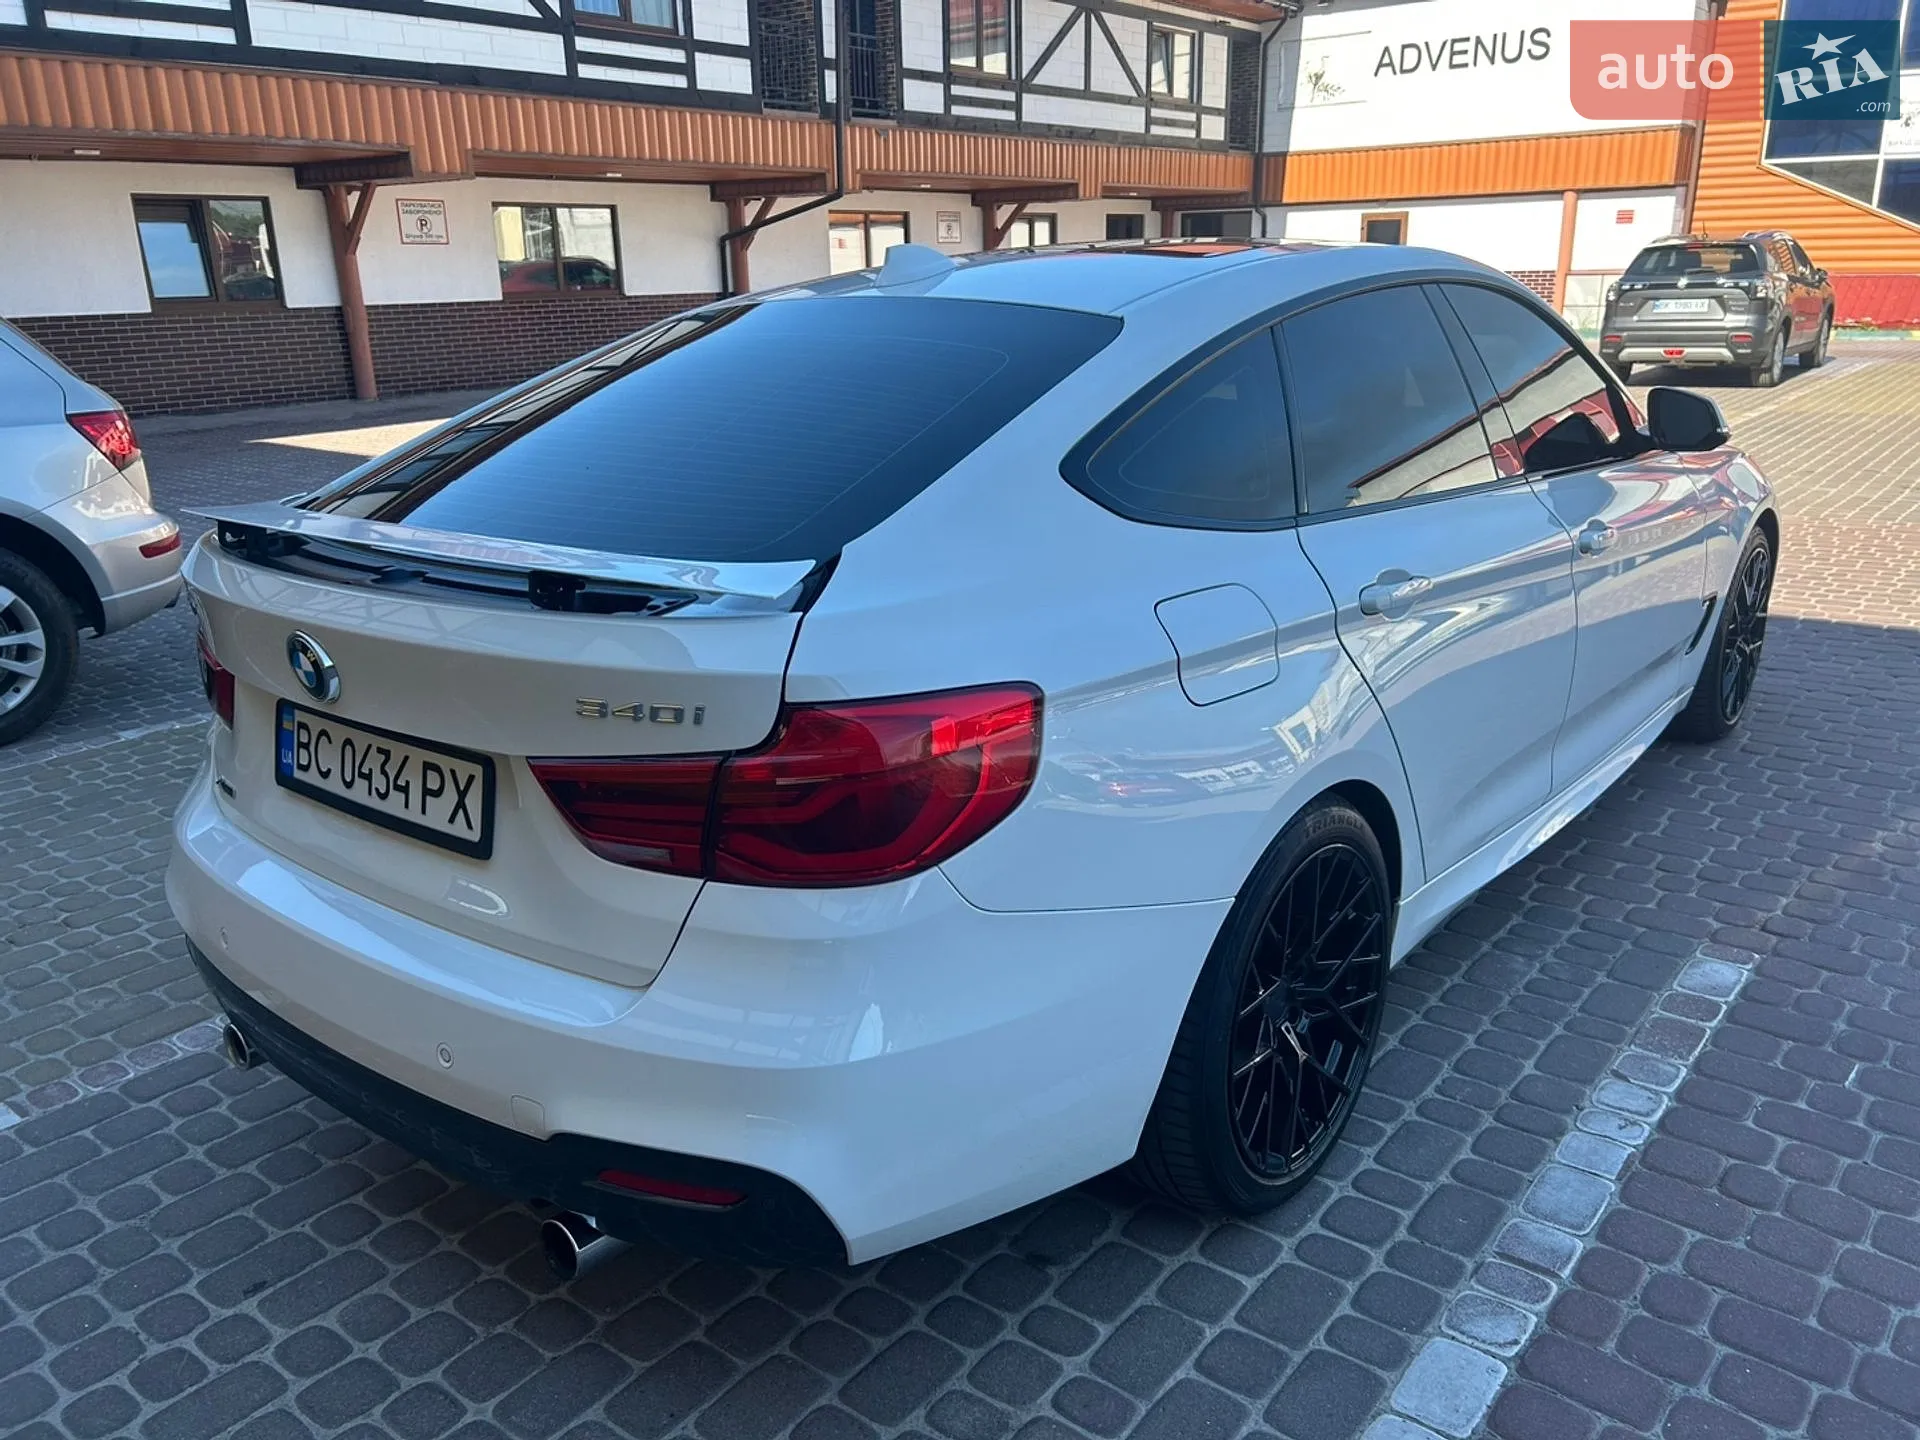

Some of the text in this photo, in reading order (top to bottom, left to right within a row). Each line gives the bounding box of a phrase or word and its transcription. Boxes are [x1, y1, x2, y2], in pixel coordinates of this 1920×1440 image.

[1374, 27, 1552, 78] ADVENUS
[575, 697, 706, 725] 340i
[281, 746, 294, 766] UA
[296, 720, 476, 831] BC 0434 PX
